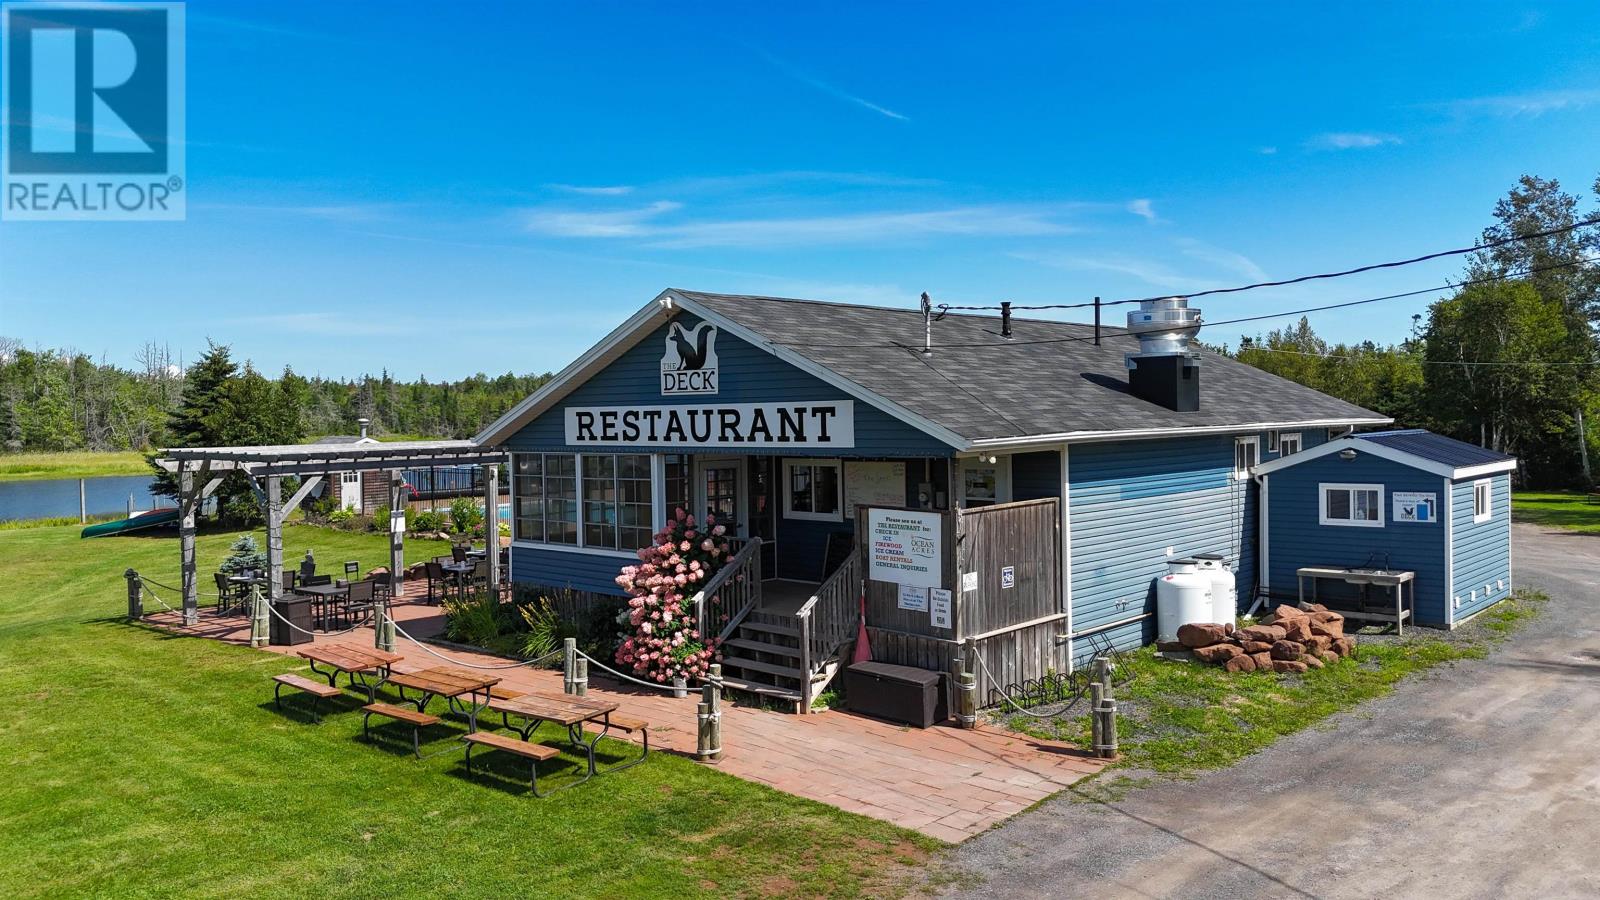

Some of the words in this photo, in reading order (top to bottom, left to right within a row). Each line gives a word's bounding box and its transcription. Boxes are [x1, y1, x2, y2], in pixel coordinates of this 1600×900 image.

[663, 371, 715, 391] DECK
[576, 406, 836, 443] RESTAURANT
[889, 523, 920, 532] RESTAURANT
[875, 541, 903, 549] FIREWOOD
[911, 540, 934, 548] OCEAN
[900, 564, 928, 572] INQUIRIES
